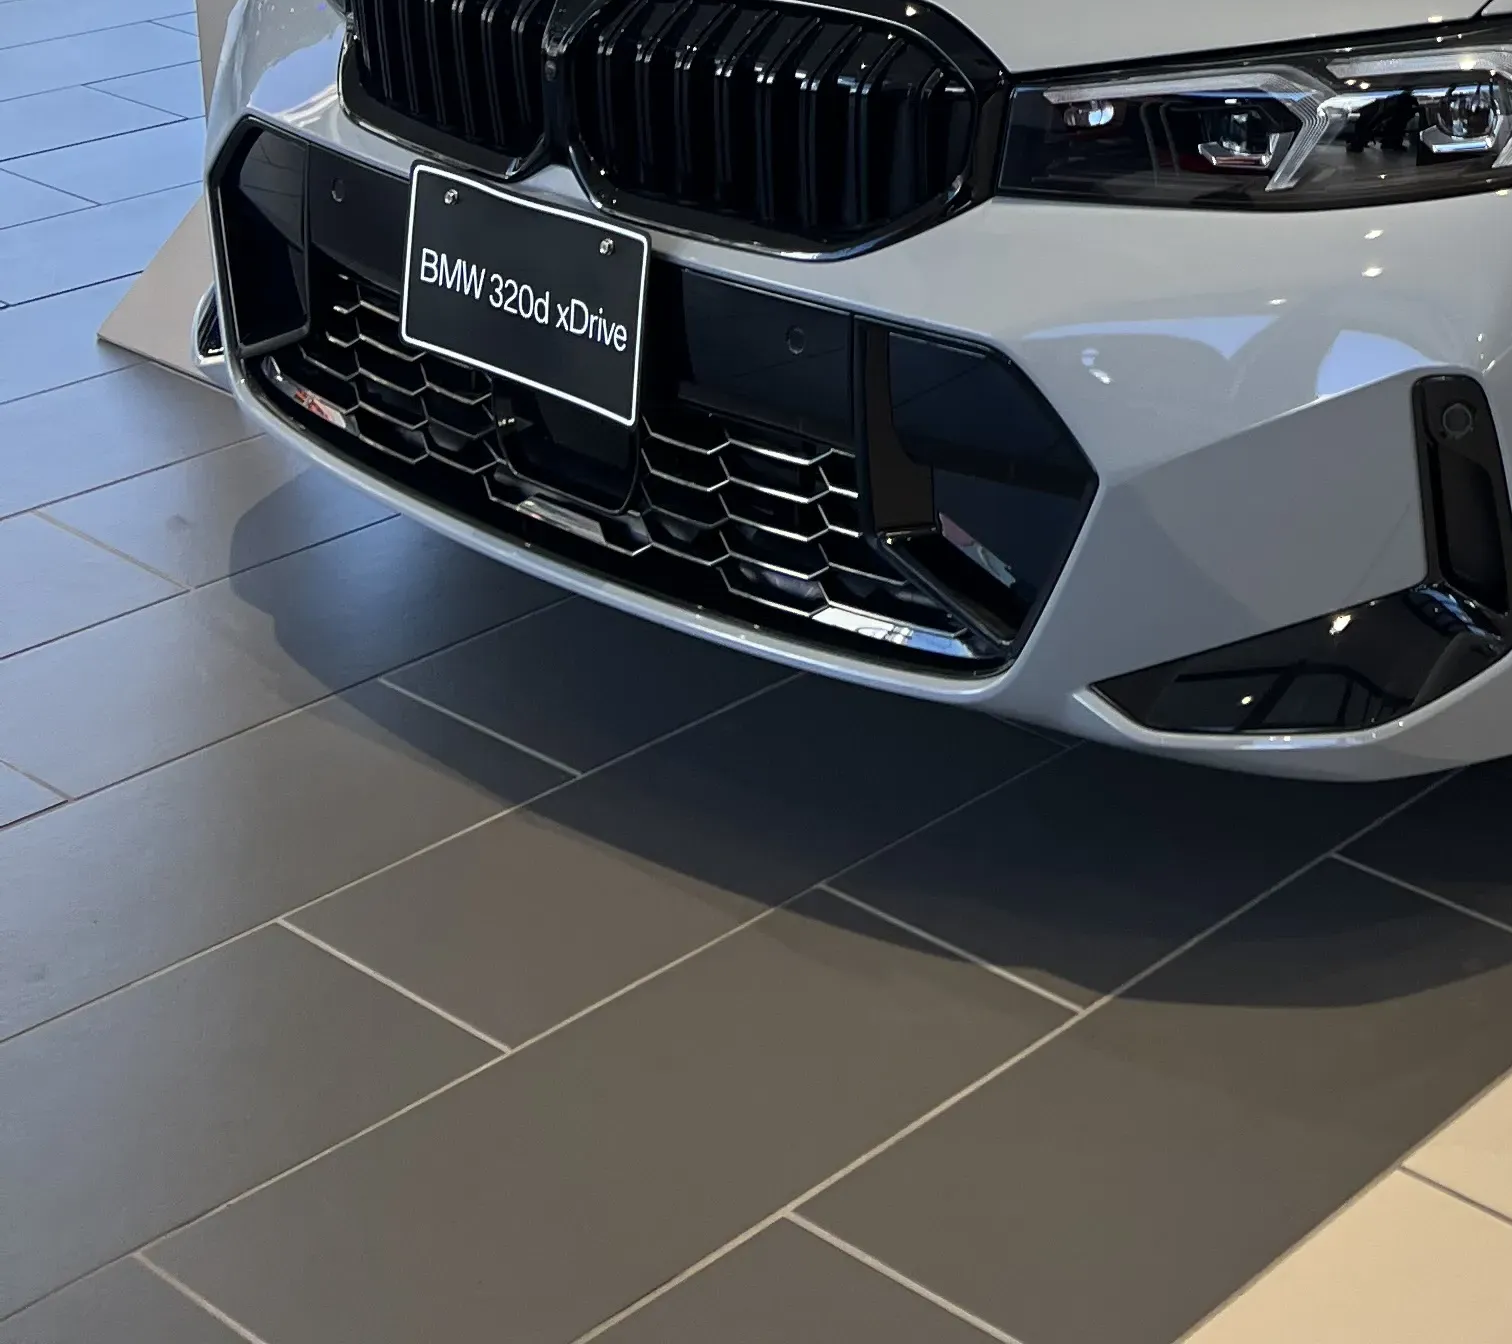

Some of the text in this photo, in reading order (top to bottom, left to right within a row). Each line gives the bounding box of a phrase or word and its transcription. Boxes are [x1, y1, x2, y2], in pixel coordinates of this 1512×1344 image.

[420, 247, 628, 352] BMW 320d xDrive
